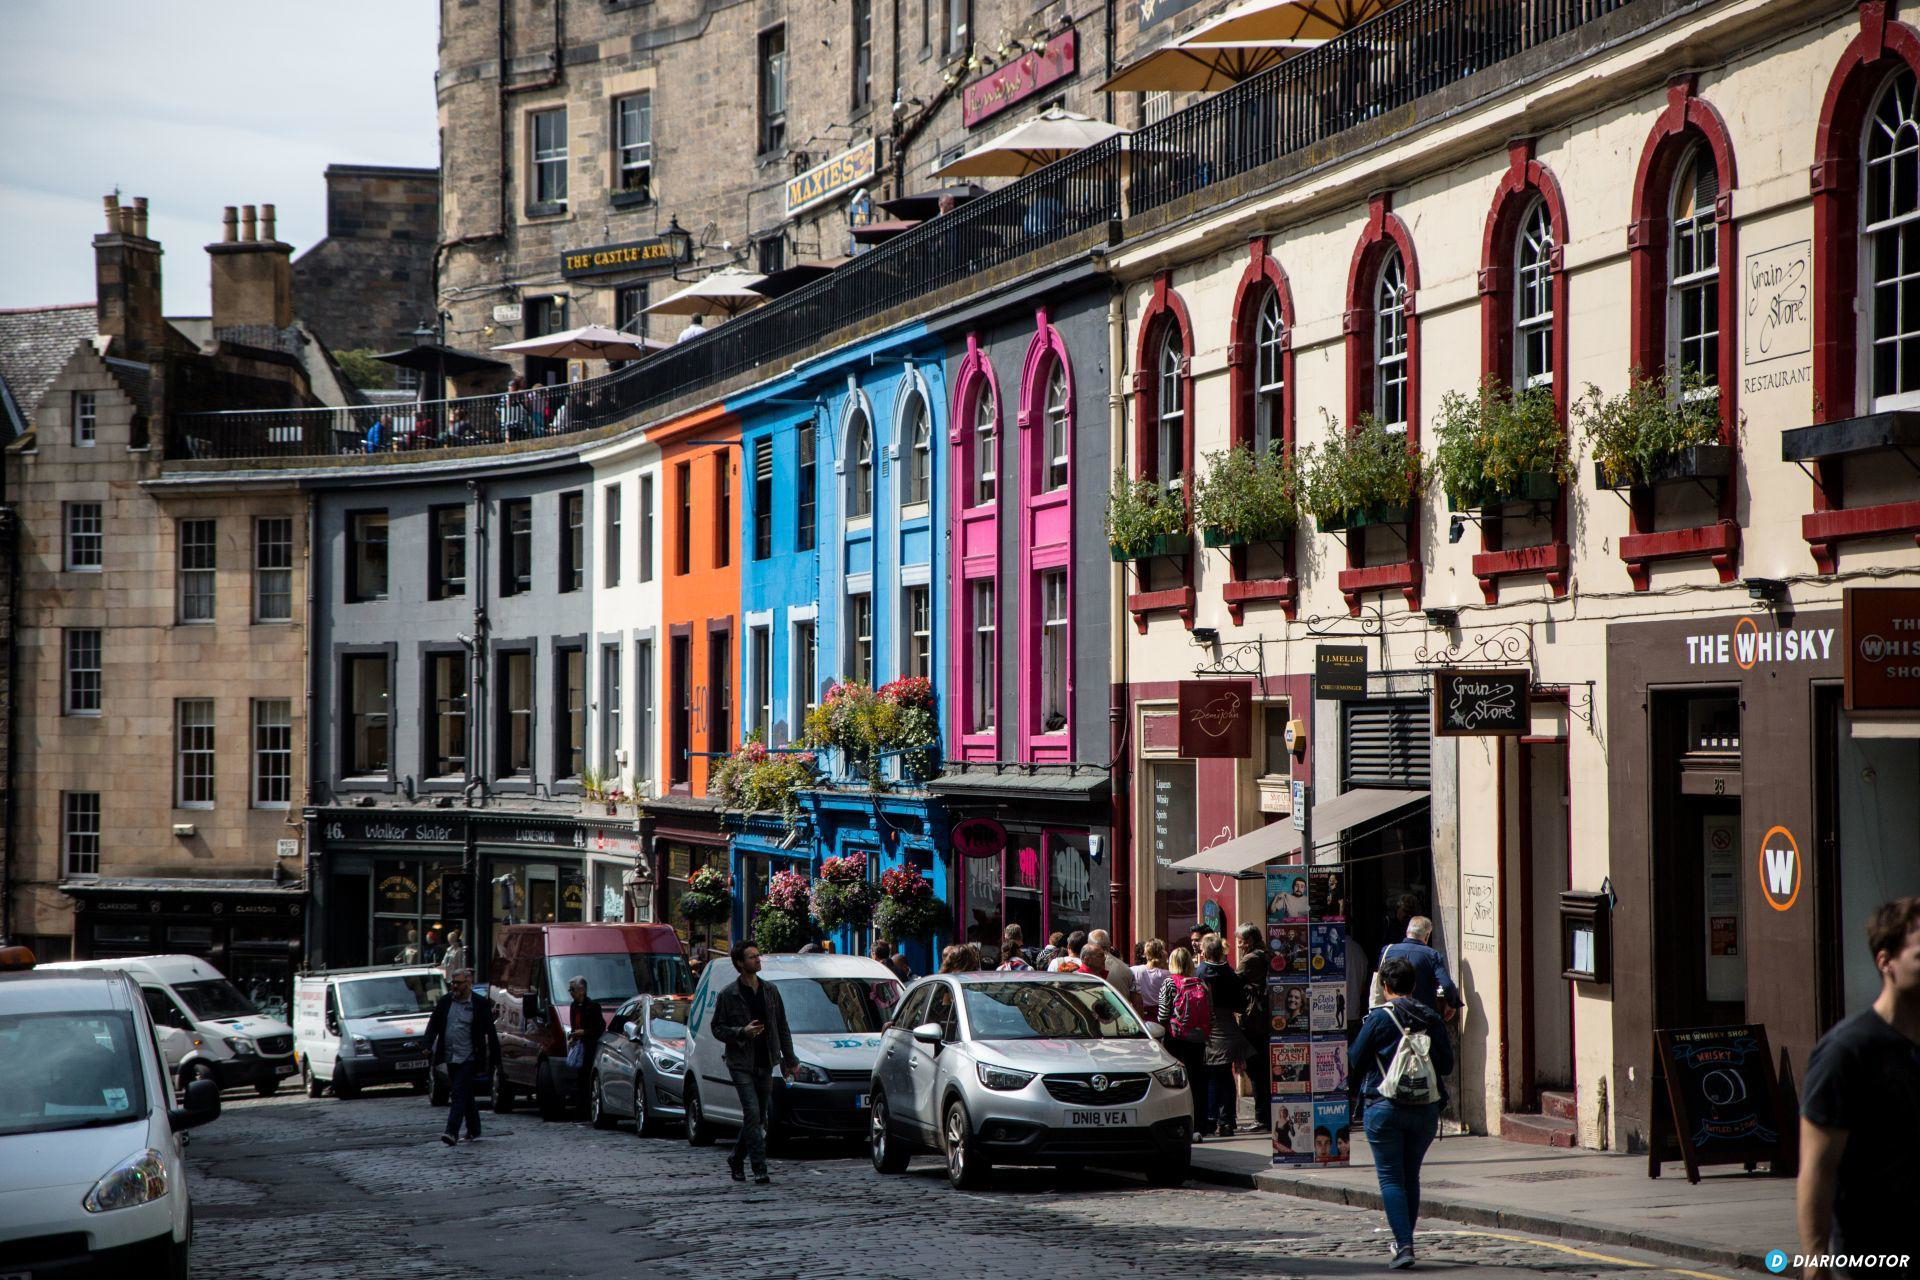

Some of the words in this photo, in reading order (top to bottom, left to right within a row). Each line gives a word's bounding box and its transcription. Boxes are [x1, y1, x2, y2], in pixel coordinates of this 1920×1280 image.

[789, 155, 855, 207] MAXIES
[566, 255, 589, 270] THE
[594, 247, 638, 265] CASTLE
[1749, 261, 1783, 317] Grain
[1744, 366, 1812, 394] RESTAURANT
[1686, 634, 1730, 664] THE
[1736, 628, 1835, 663] WHISKY
[1450, 677, 1490, 709] Grain
[365, 824, 408, 839] Walker
[416, 824, 452, 840] Slater
[516, 829, 556, 843] LADIESWEAR
[280, 840, 296, 848] WEST
[1765, 849, 1794, 894] W
[1312, 1001, 1336, 1011] Presley
[1317, 994, 1335, 1004] Elvis
[1693, 1031, 1726, 1041] WHISKY
[1277, 1053, 1305, 1062] CASH
[1696, 1051, 1732, 1061] WHISKY
[1317, 1104, 1346, 1115] TIMMY
[1105, 1111, 1128, 1125] VEA
